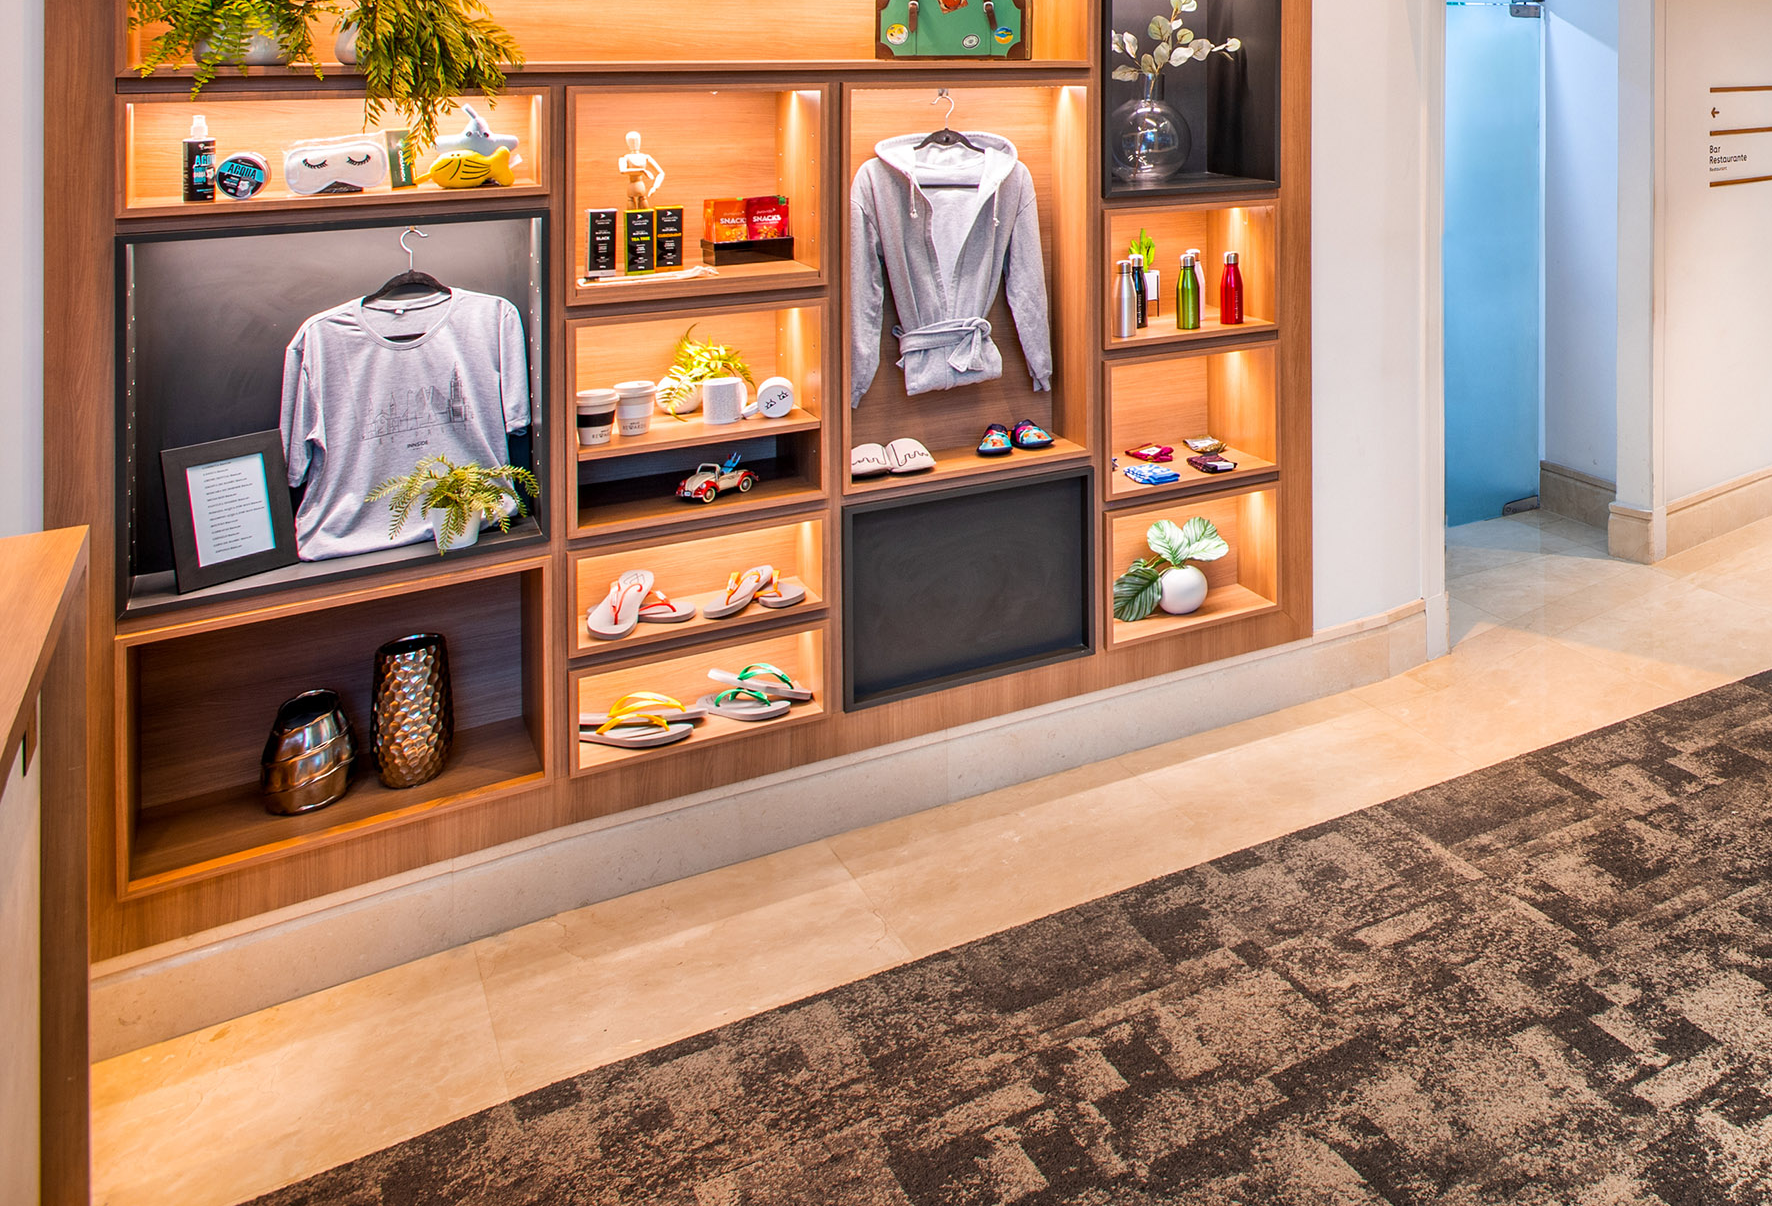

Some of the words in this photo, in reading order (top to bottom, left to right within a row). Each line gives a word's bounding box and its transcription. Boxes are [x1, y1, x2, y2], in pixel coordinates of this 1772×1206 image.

[1710, 145, 1720, 153] Bar
[1710, 154, 1747, 164] Restaurante
[228, 164, 257, 179] ACQUA
